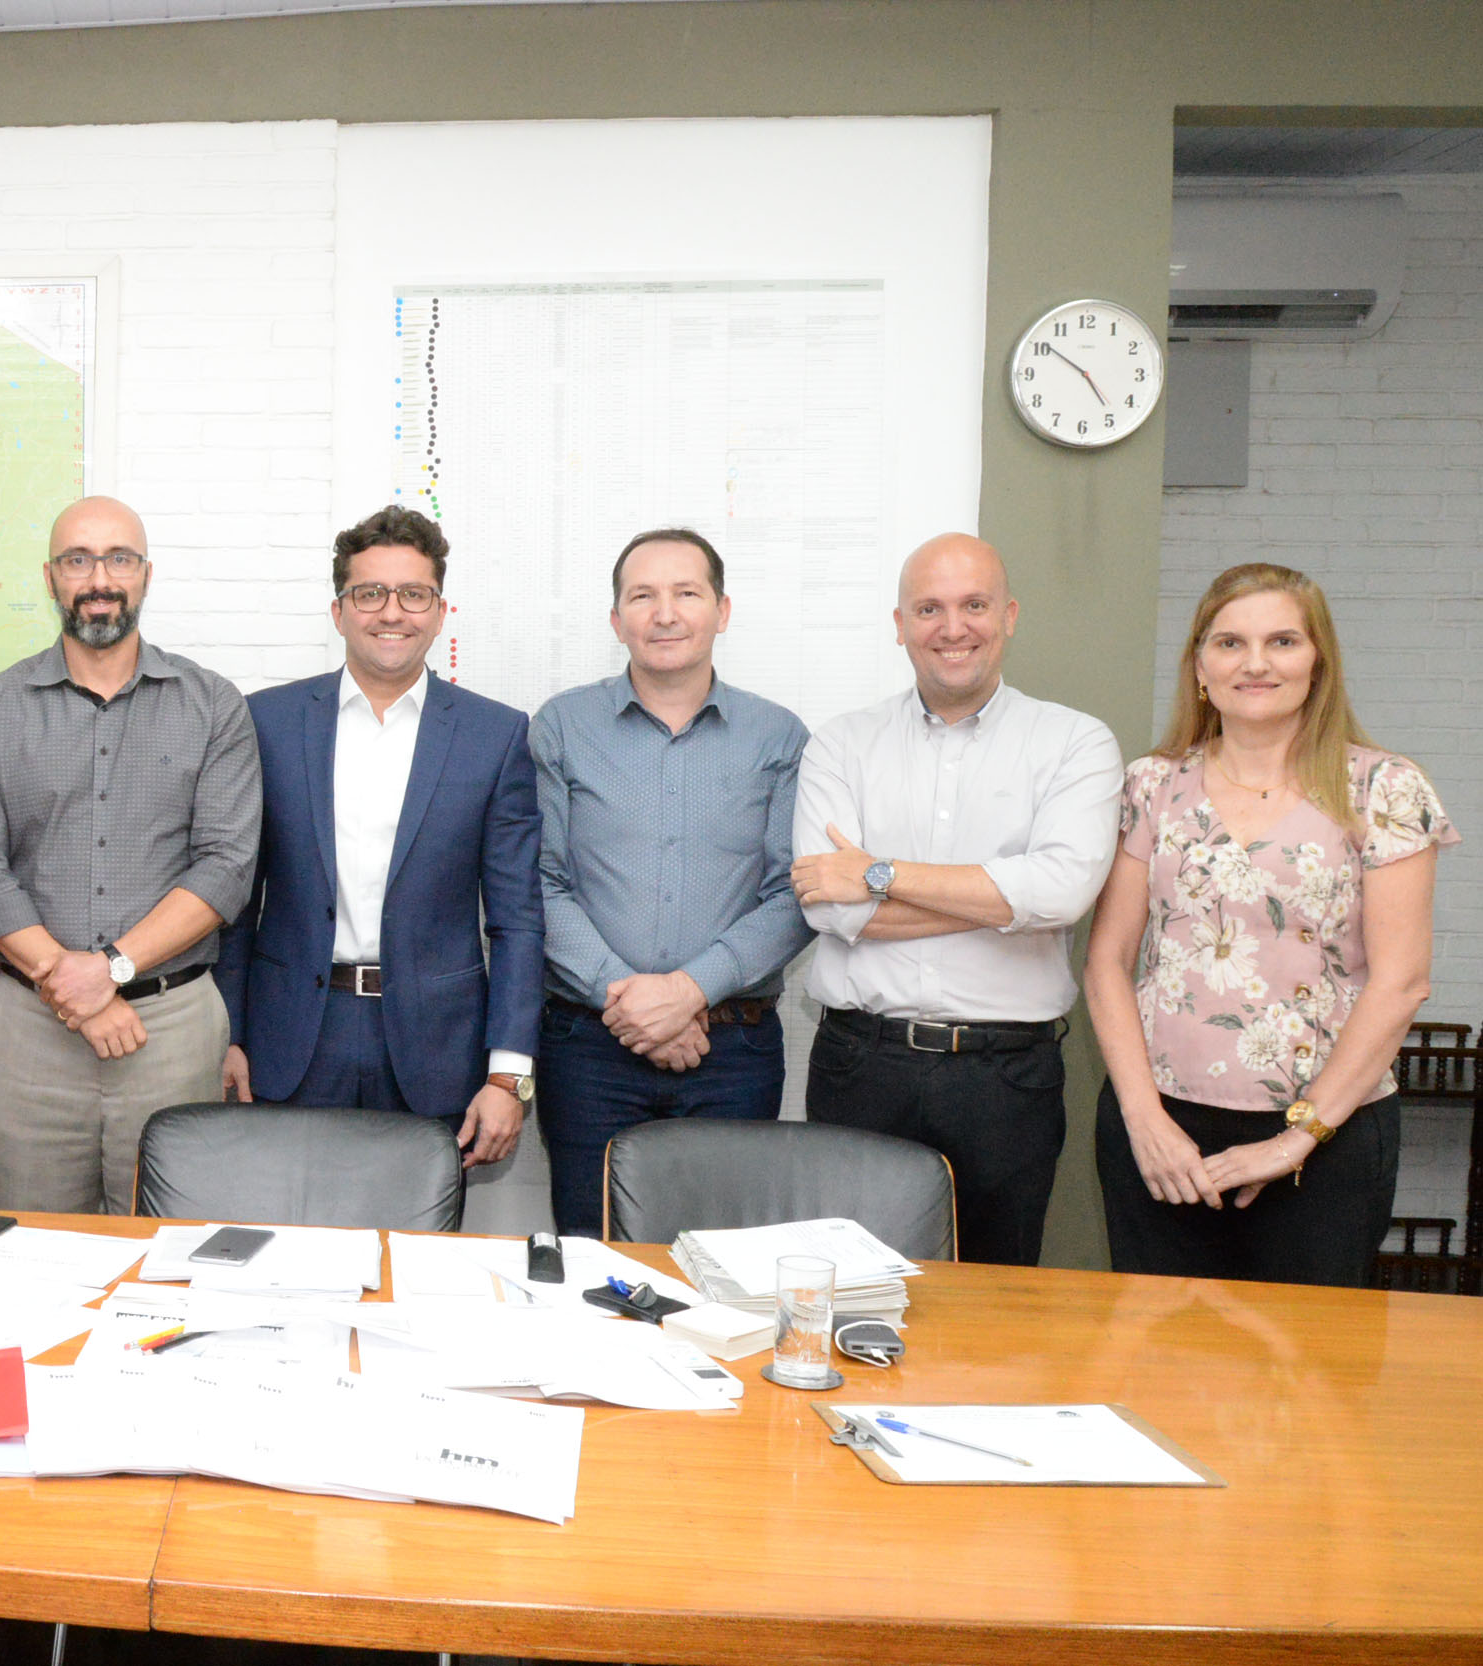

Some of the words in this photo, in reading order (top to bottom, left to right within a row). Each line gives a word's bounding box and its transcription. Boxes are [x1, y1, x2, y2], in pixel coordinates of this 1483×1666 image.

[1079, 314, 1096, 329] 12
[1054, 323, 1067, 337] 11
[1110, 322, 1116, 336] 1
[1033, 342, 1051, 356] 10
[1128, 341, 1138, 355] 2
[1024, 367, 1035, 381] 9
[1135, 368, 1145, 382] 3
[1032, 394, 1042, 408] 8
[1125, 394, 1134, 408] 4
[1052, 413, 1061, 427] 7
[1104, 414, 1115, 428] 5
[1077, 420, 1088, 435] 6
[440, 1448, 499, 1468] hm
